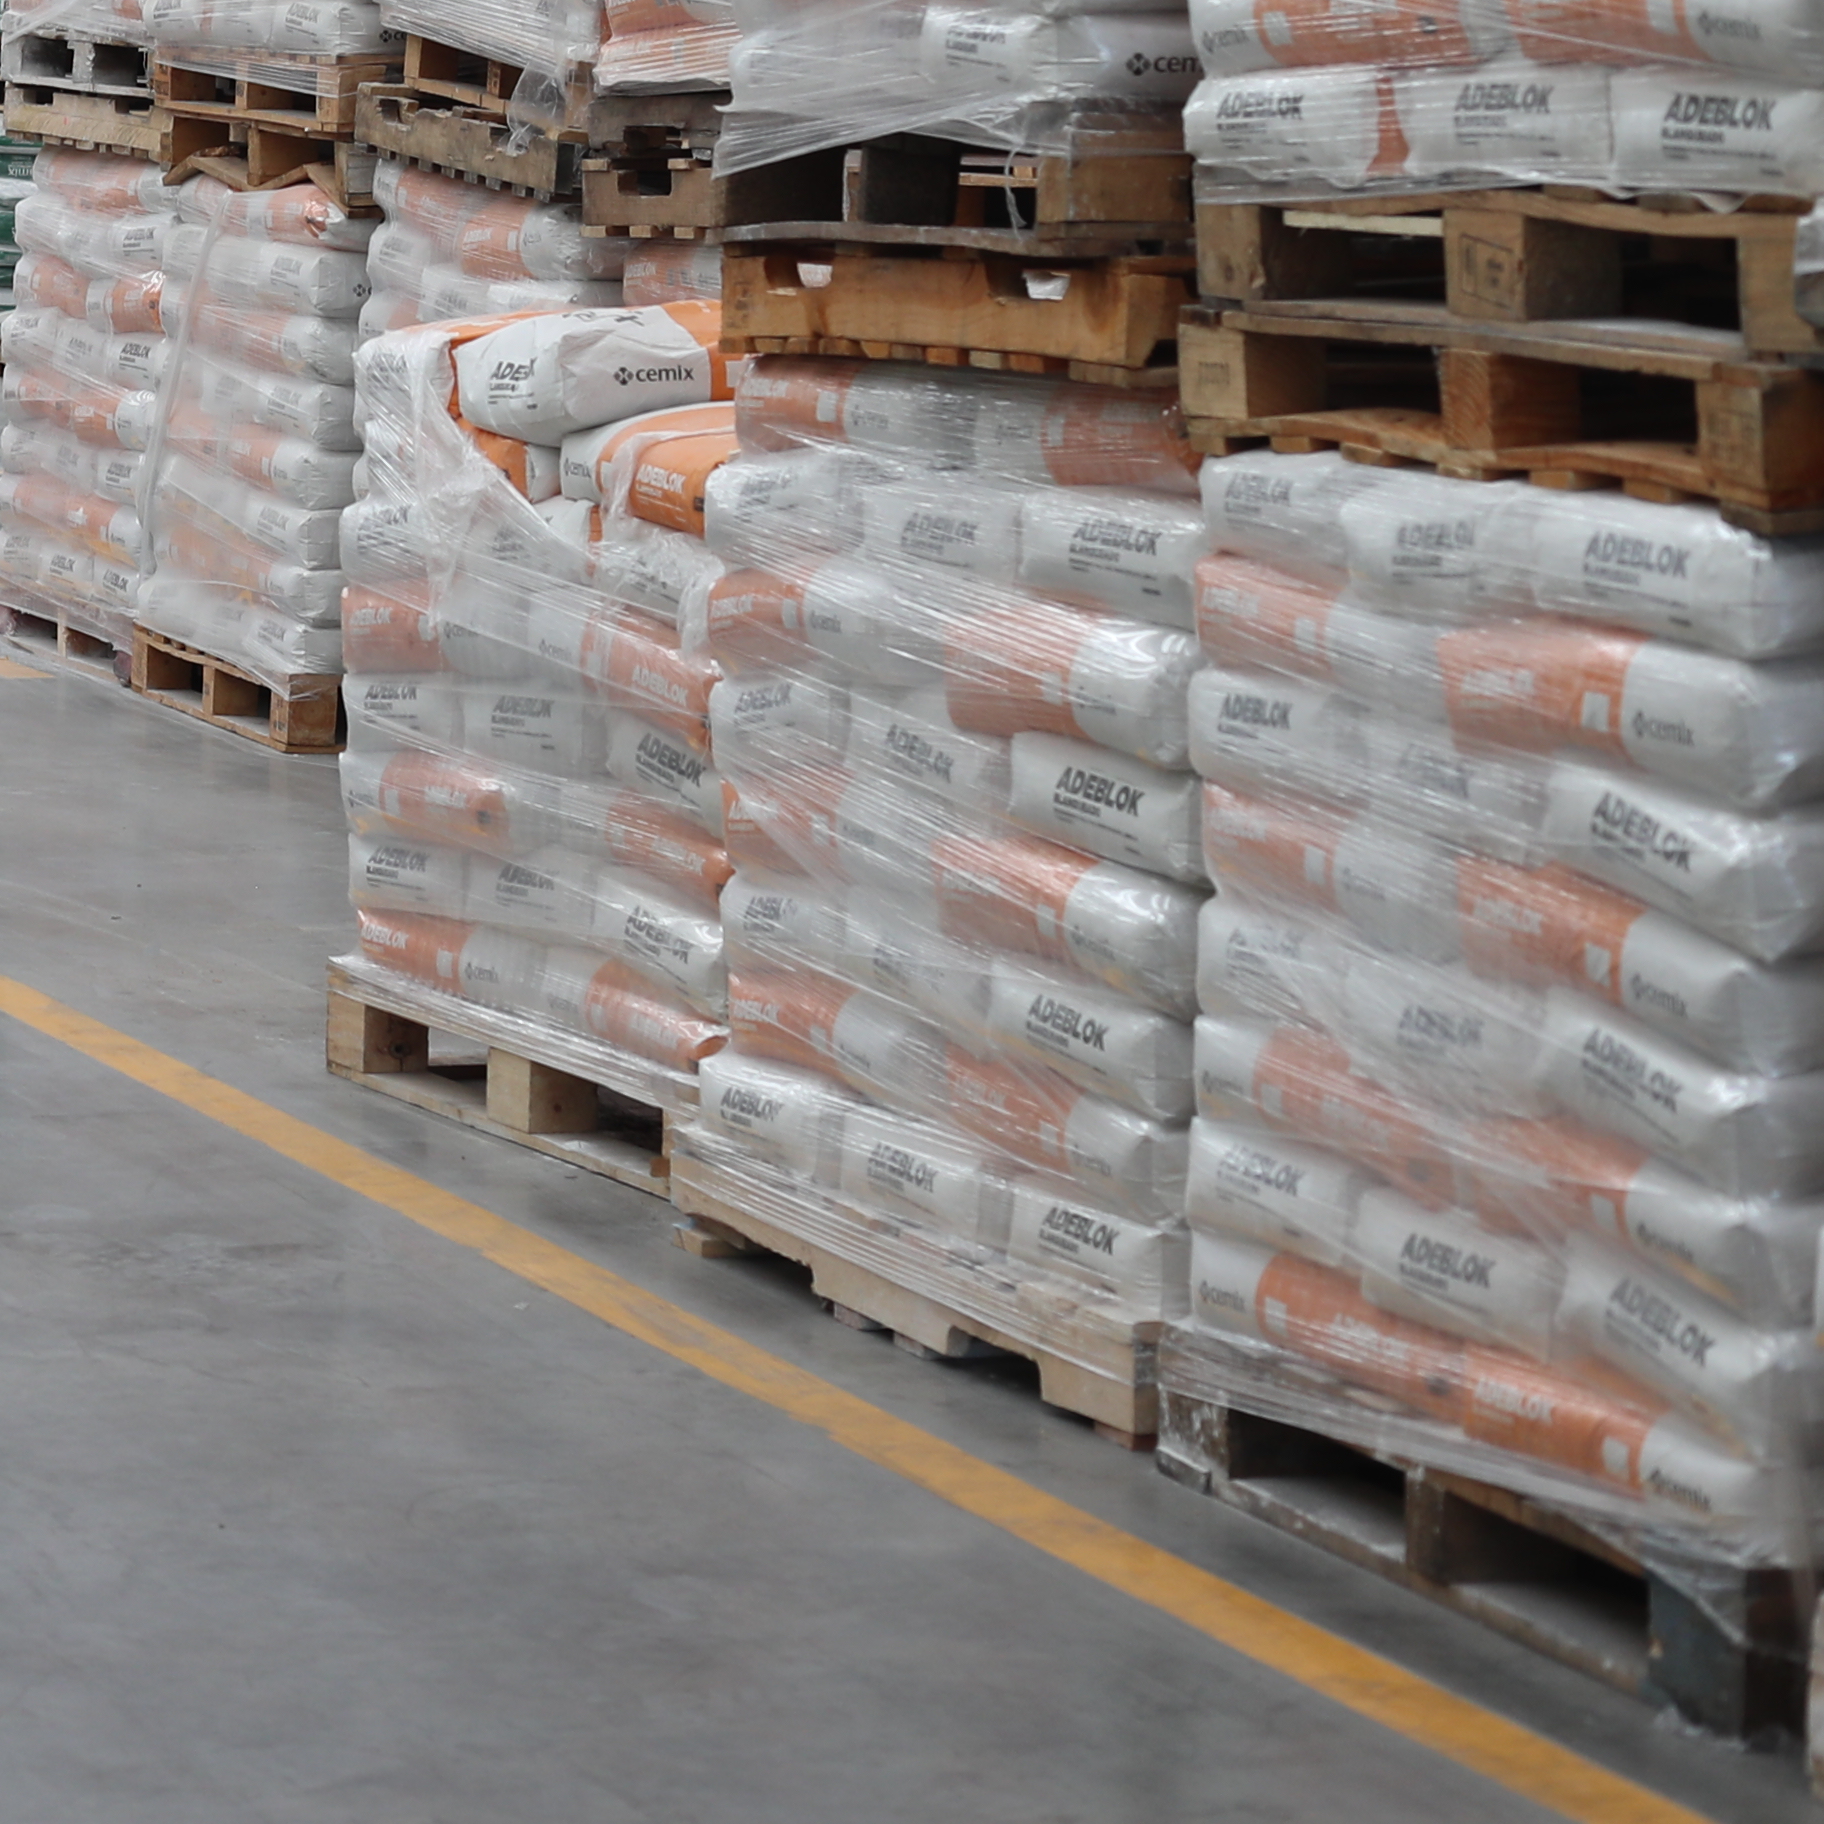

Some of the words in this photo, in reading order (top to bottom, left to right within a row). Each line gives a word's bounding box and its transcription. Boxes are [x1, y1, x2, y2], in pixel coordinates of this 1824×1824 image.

[1217, 91, 1304, 119] ADEBLOK
[1455, 83, 1554, 114] ADEBLOK
[1664, 93, 1777, 130] ADEBLOK
[636, 365, 695, 384] cemix
[636, 465, 687, 494] ADEBLOK
[1586, 529, 1692, 580] ADEBLOK
[363, 683, 419, 702] ADEBLOK
[633, 667, 688, 705] ADEBLOK
[1220, 693, 1294, 732] ADEBLOK
[636, 732, 706, 788] ADEBLOK
[1056, 767, 1146, 816] ADEBLOK
[1595, 792, 1693, 873] ADEBLOK
[367, 847, 429, 871] ADEBLOK
[360, 921, 409, 949] ADEBLOK
[1027, 995, 1109, 1051] ADEBLOK
[1584, 1027, 1684, 1114] ADEBLOK
[720, 1088, 784, 1122] ADEBLOK
[1042, 1207, 1121, 1255] ADEBLOK
[1401, 1232, 1496, 1290] ADEBLOK
[1611, 1277, 1716, 1368] ADEBLOK
[1473, 1374, 1555, 1421] ADEBLOK
